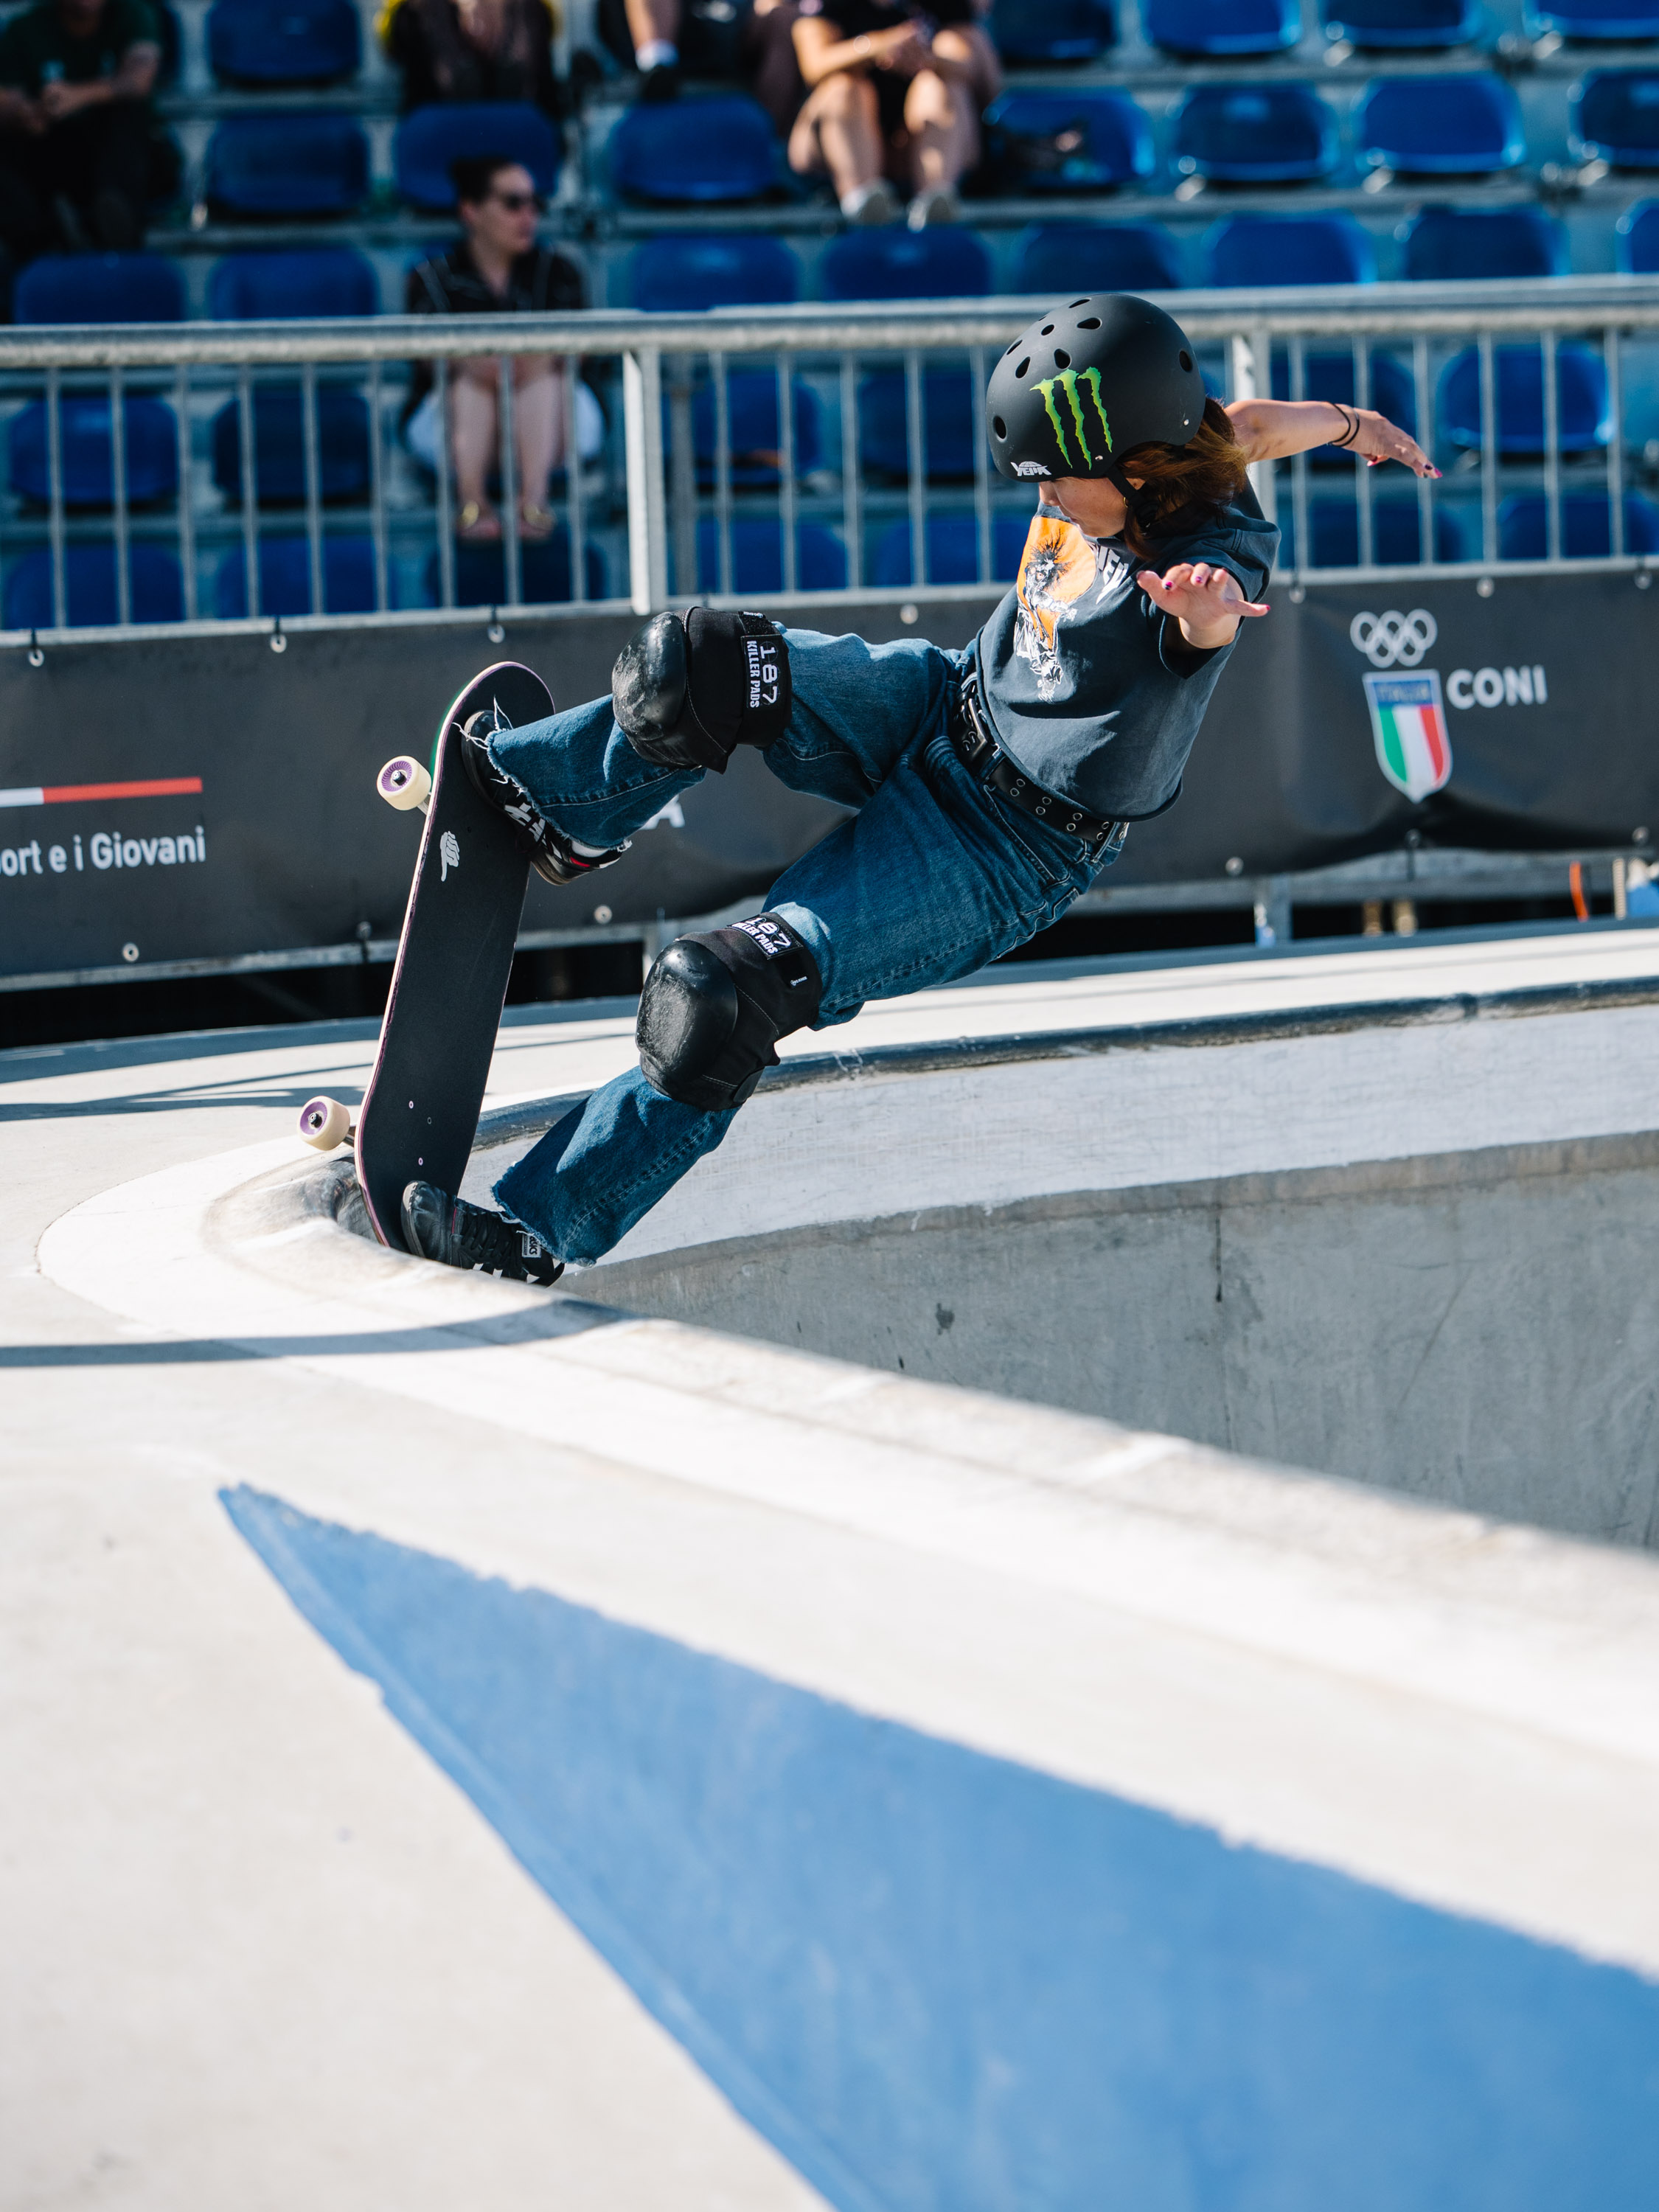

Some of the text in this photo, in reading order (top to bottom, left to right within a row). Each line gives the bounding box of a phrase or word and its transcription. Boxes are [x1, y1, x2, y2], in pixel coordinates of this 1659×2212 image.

[747, 640, 761, 709] KILLER PADS
[760, 645, 778, 704] 187
[1446, 664, 1548, 710] CONI
[0, 824, 206, 877] ort e i Giovani
[745, 917, 791, 948] 187
[754, 933, 779, 954] PADS
